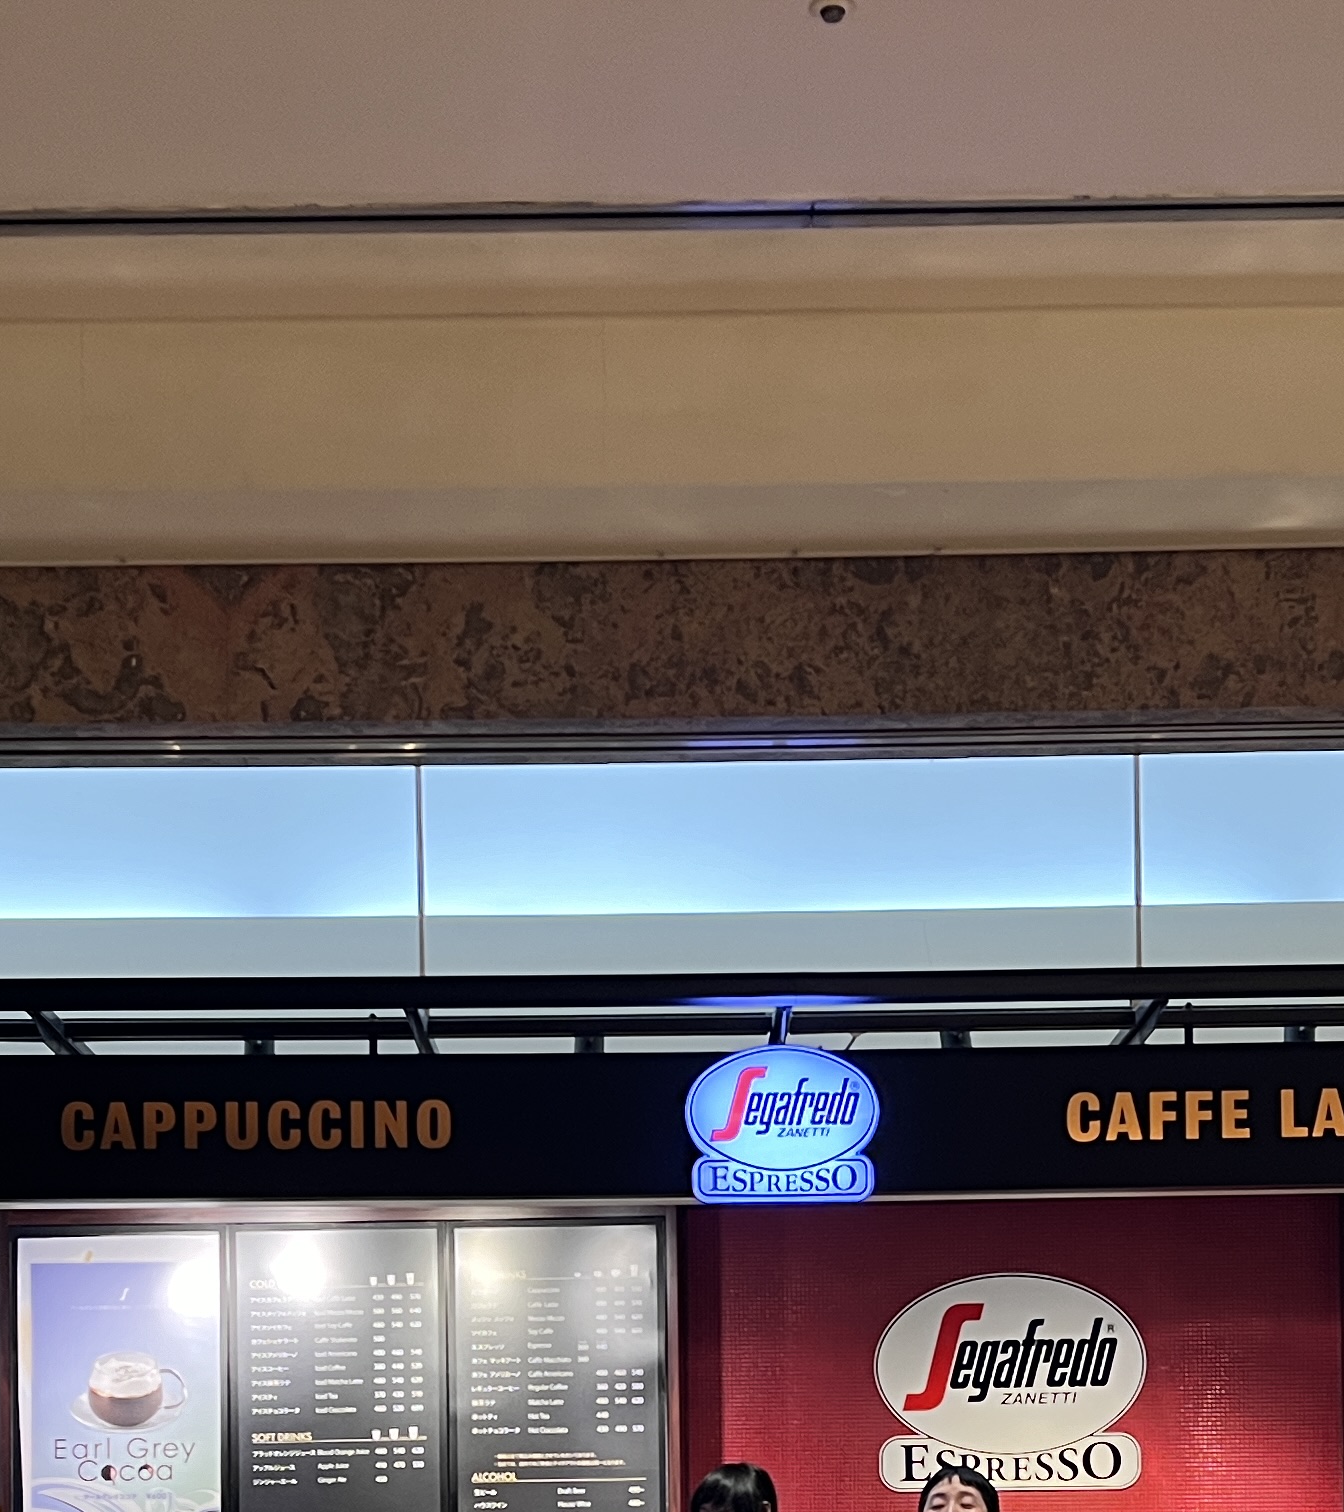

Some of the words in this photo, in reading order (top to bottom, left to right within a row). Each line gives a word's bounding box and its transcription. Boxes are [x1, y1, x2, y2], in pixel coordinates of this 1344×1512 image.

[709, 1066, 860, 1142] Segafredo
[1066, 1090, 1250, 1142] CAFFE
[61, 1099, 453, 1151] CAPPUCCINO
[776, 1127, 830, 1138] ZANETTI
[708, 1164, 858, 1193] ESPRESSO
[903, 1303, 1118, 1411] Segafredo
[1000, 1392, 1077, 1404] ZANETTI
[54, 1437, 111, 1459] Earl
[127, 1437, 196, 1463] Grey
[900, 1441, 1122, 1482] ESPRESSO
[77, 1459, 173, 1485] Cocoa
[471, 1472, 518, 1483] ALCOHOL
